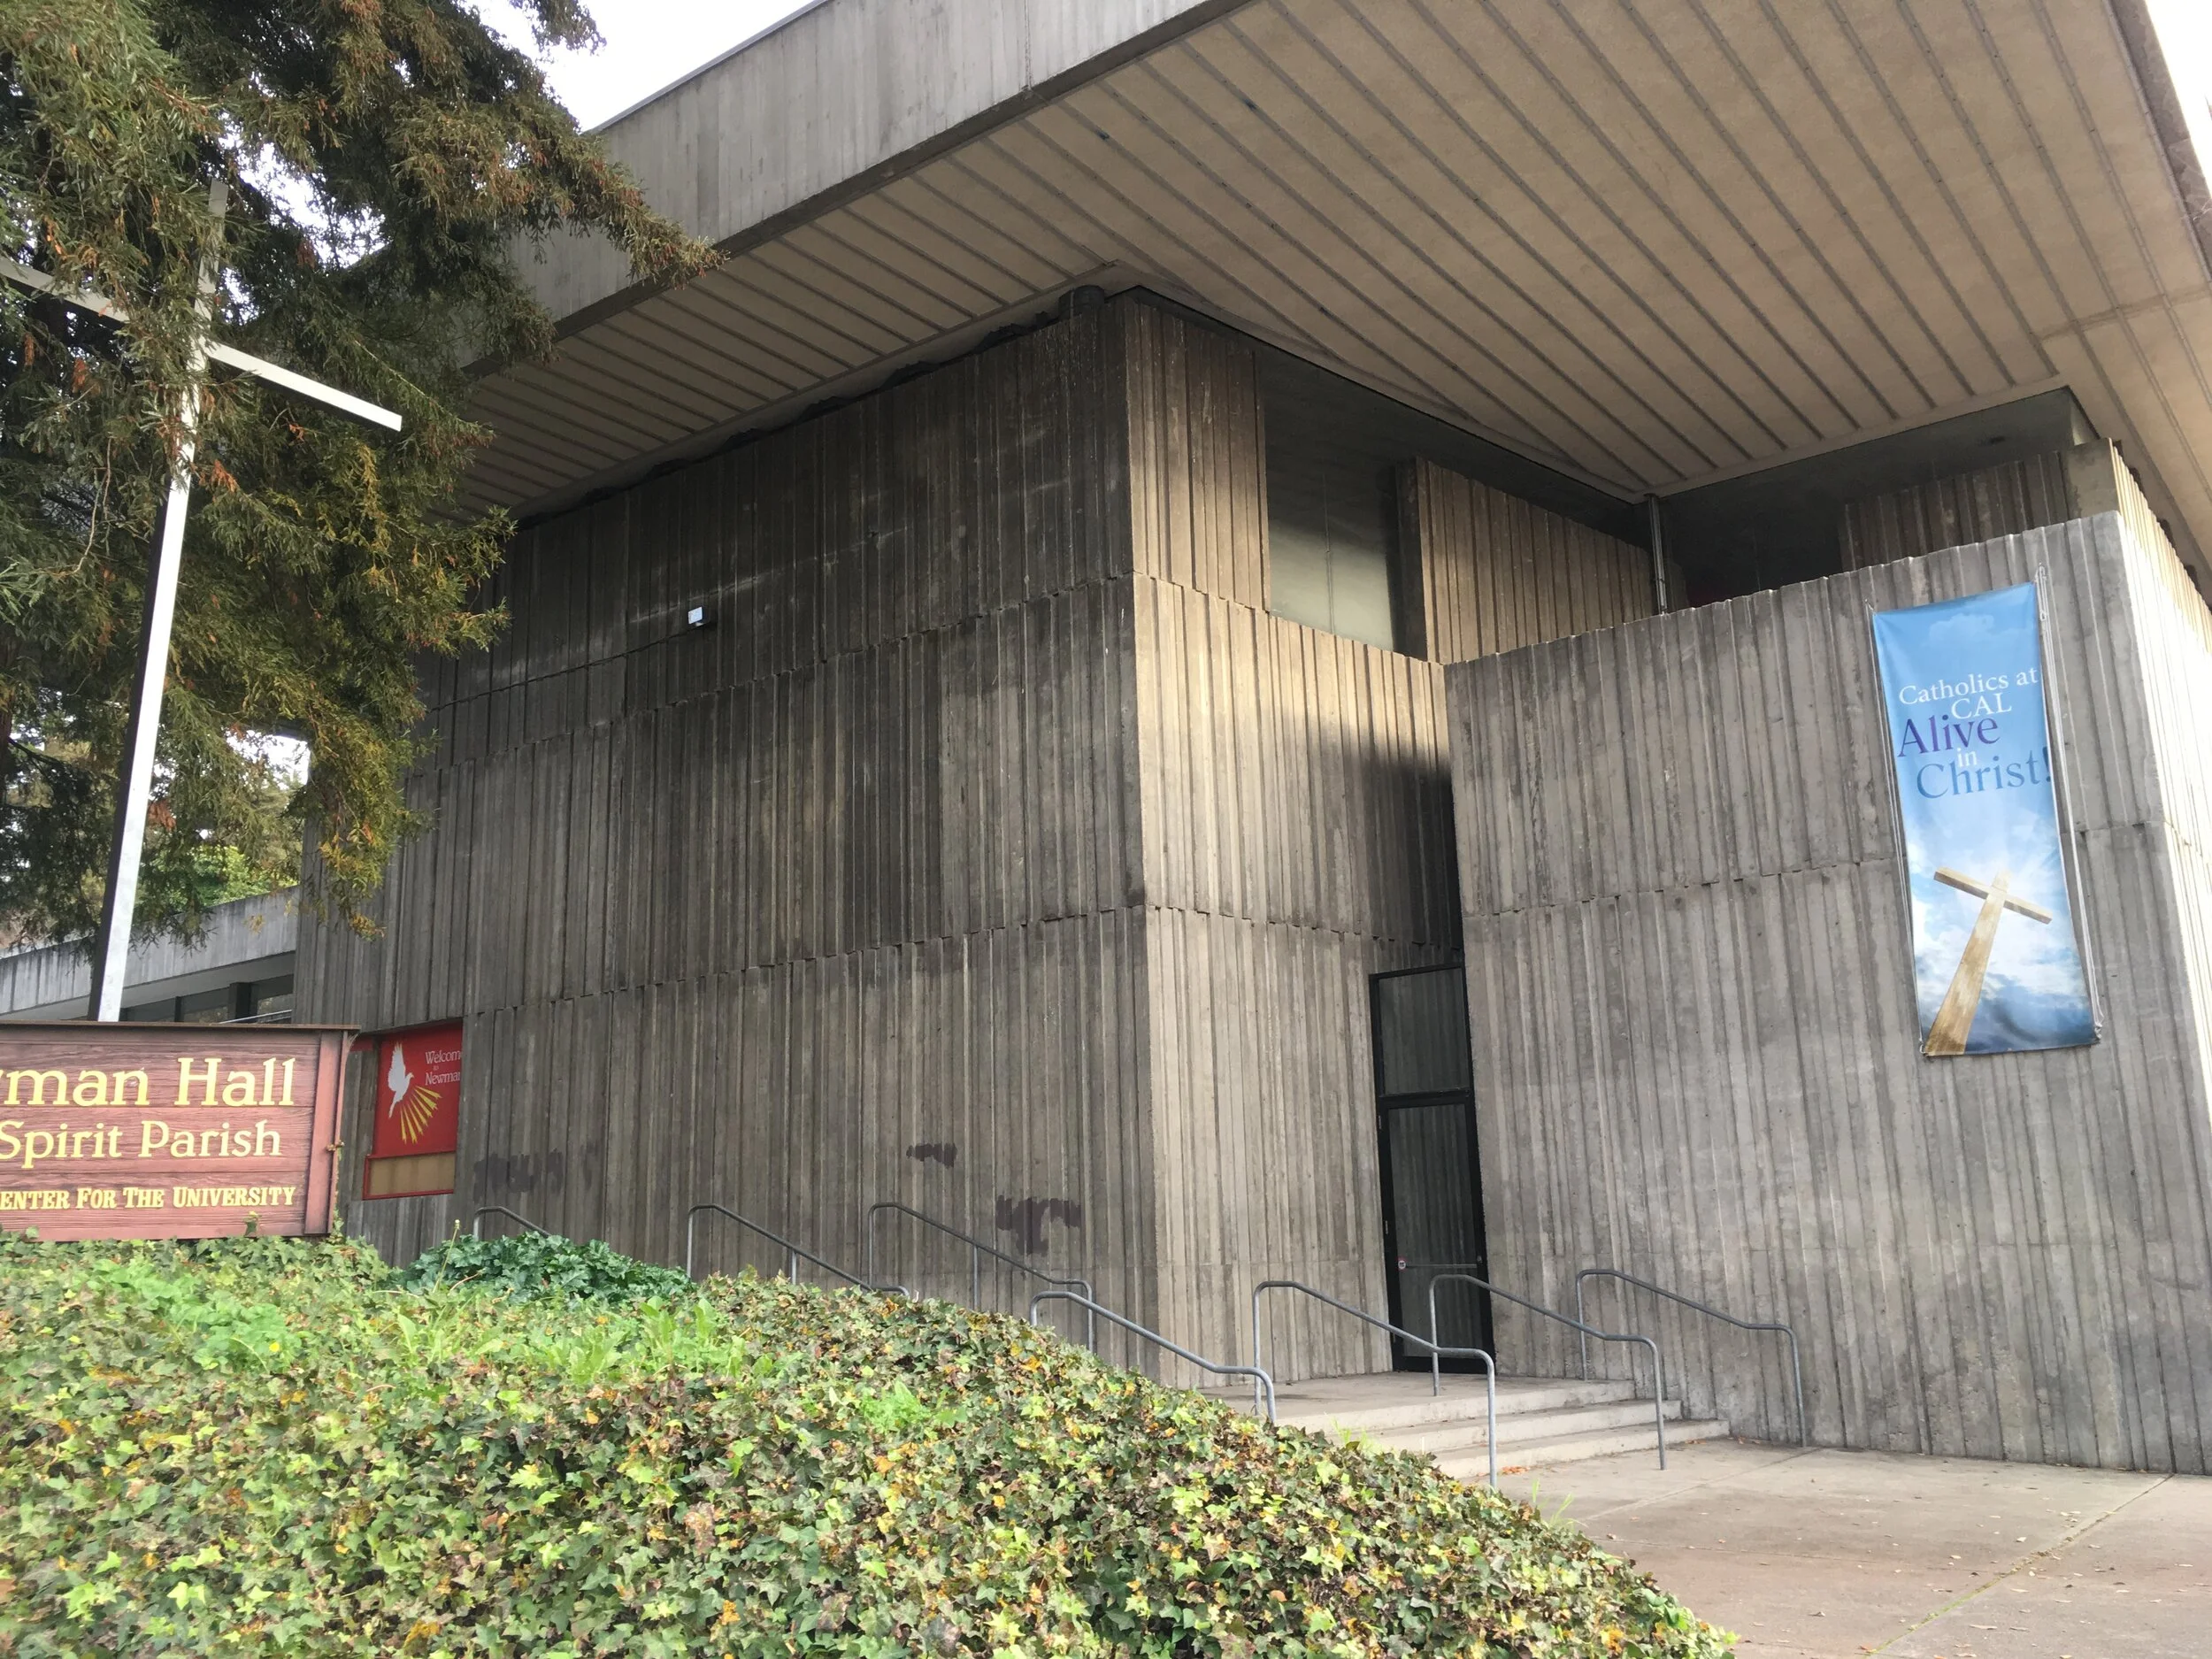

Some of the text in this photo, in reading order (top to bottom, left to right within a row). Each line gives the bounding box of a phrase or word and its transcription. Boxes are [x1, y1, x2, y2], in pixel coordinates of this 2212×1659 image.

[1899, 667, 2039, 705] Catholics at
[1951, 693, 2012, 719] CAL
[1897, 714, 2001, 757] Alive
[1916, 747, 2051, 799] Christ!
[1956, 748, 1978, 768] in
[425, 1050, 461, 1064] Welcom
[0, 1057, 296, 1106] man Hall
[0, 1119, 281, 1169] Spirit Parish
[76, 1187, 116, 1209] FOR
[122, 1187, 164, 1209] THE
[173, 1186, 296, 1207] UNIVERSITY
